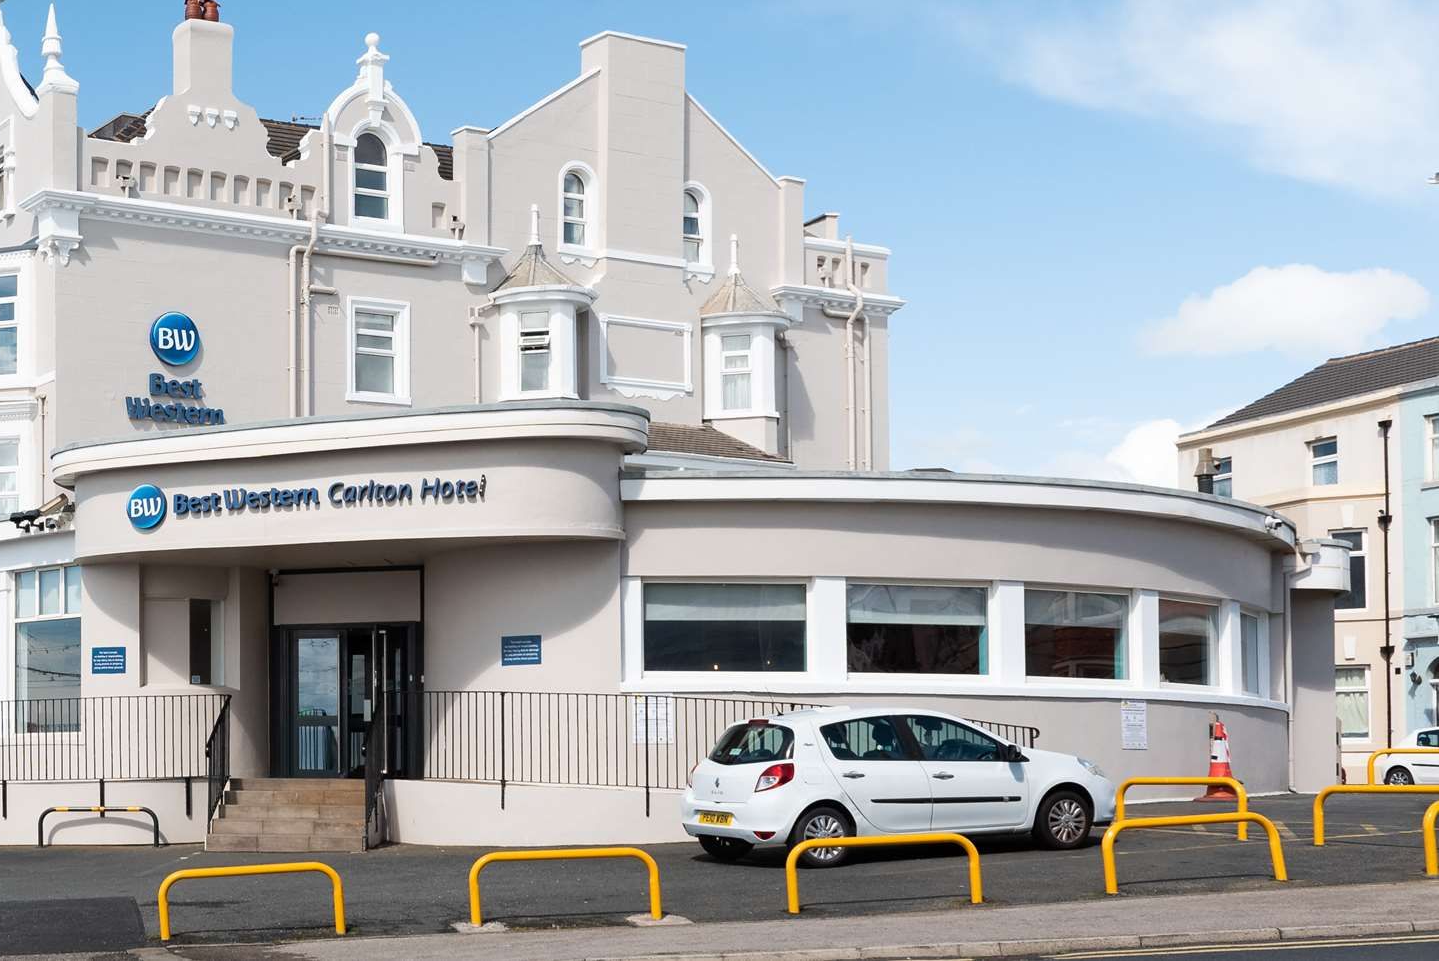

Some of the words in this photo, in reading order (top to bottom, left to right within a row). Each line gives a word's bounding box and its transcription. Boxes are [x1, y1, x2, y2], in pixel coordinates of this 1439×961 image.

[158, 327, 195, 351] BW
[149, 372, 202, 400] Best
[125, 396, 225, 425] Western
[130, 496, 161, 518] BW
[173, 493, 222, 515] Best
[223, 487, 320, 511] Western
[328, 479, 412, 505] Carlton
[420, 474, 486, 500] Hotel
